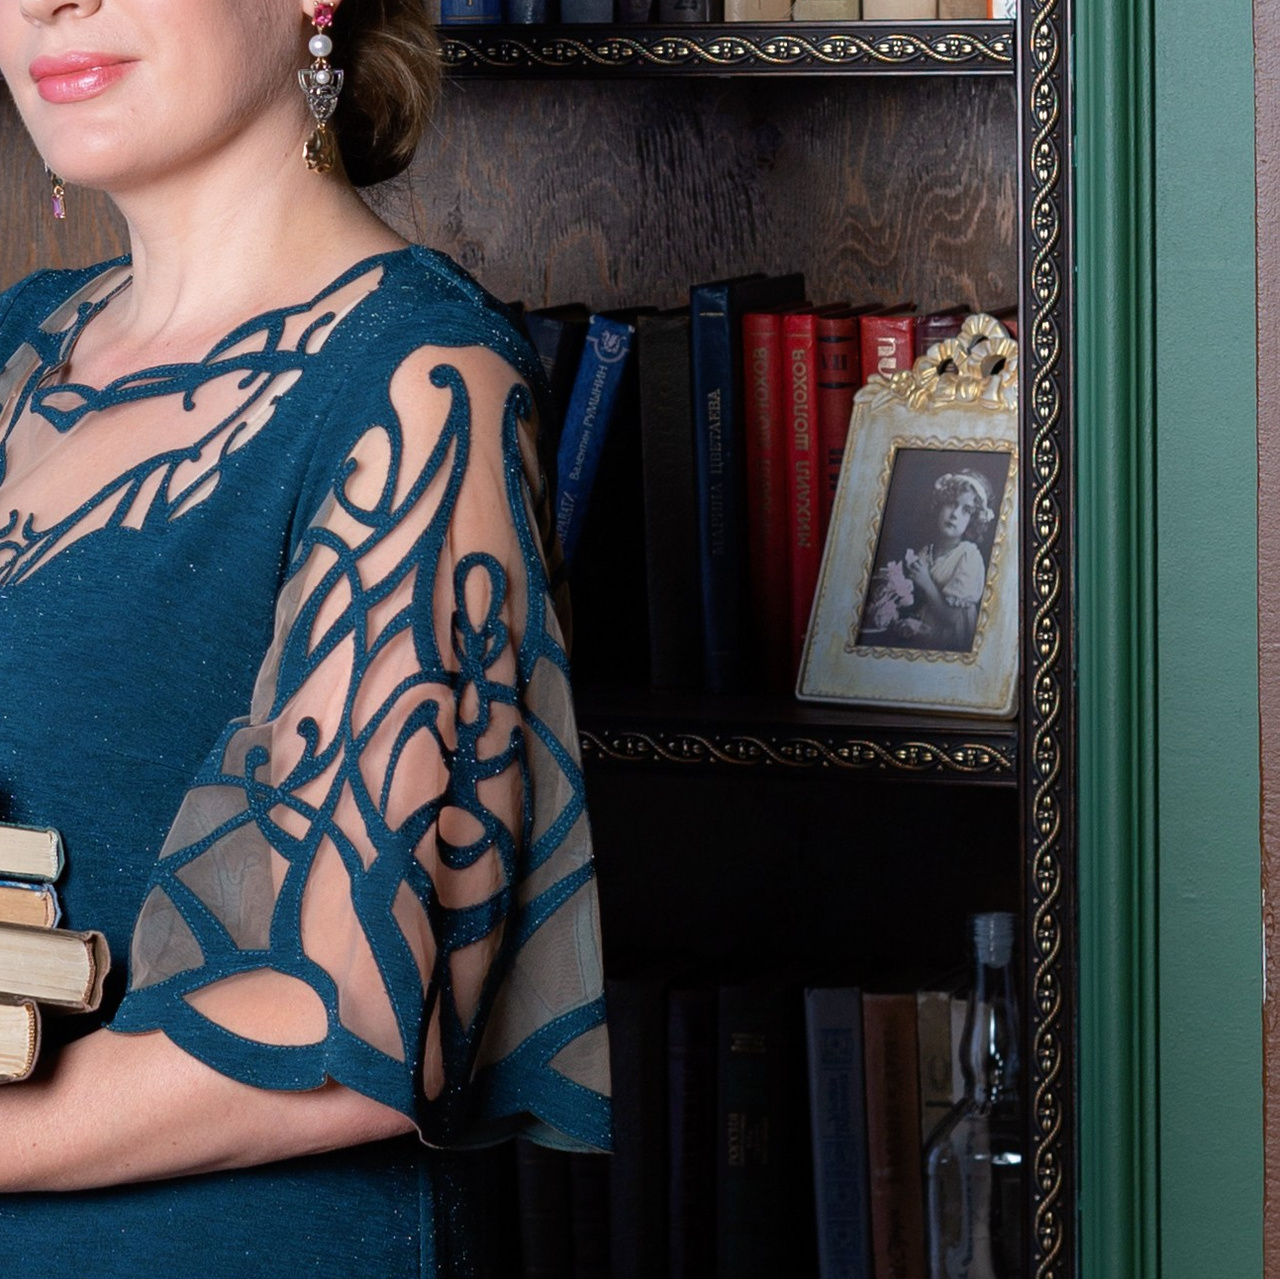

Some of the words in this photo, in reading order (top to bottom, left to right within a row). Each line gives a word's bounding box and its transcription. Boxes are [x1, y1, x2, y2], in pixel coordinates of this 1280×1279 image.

[568, 430, 591, 481] Валентин
[582, 364, 608, 427] РУМЫНИН
[707, 388, 724, 475] ЦВЕТАЕВА
[791, 349, 809, 451] ШОЛОХОВ
[795, 460, 811, 548] МИХАИЛ
